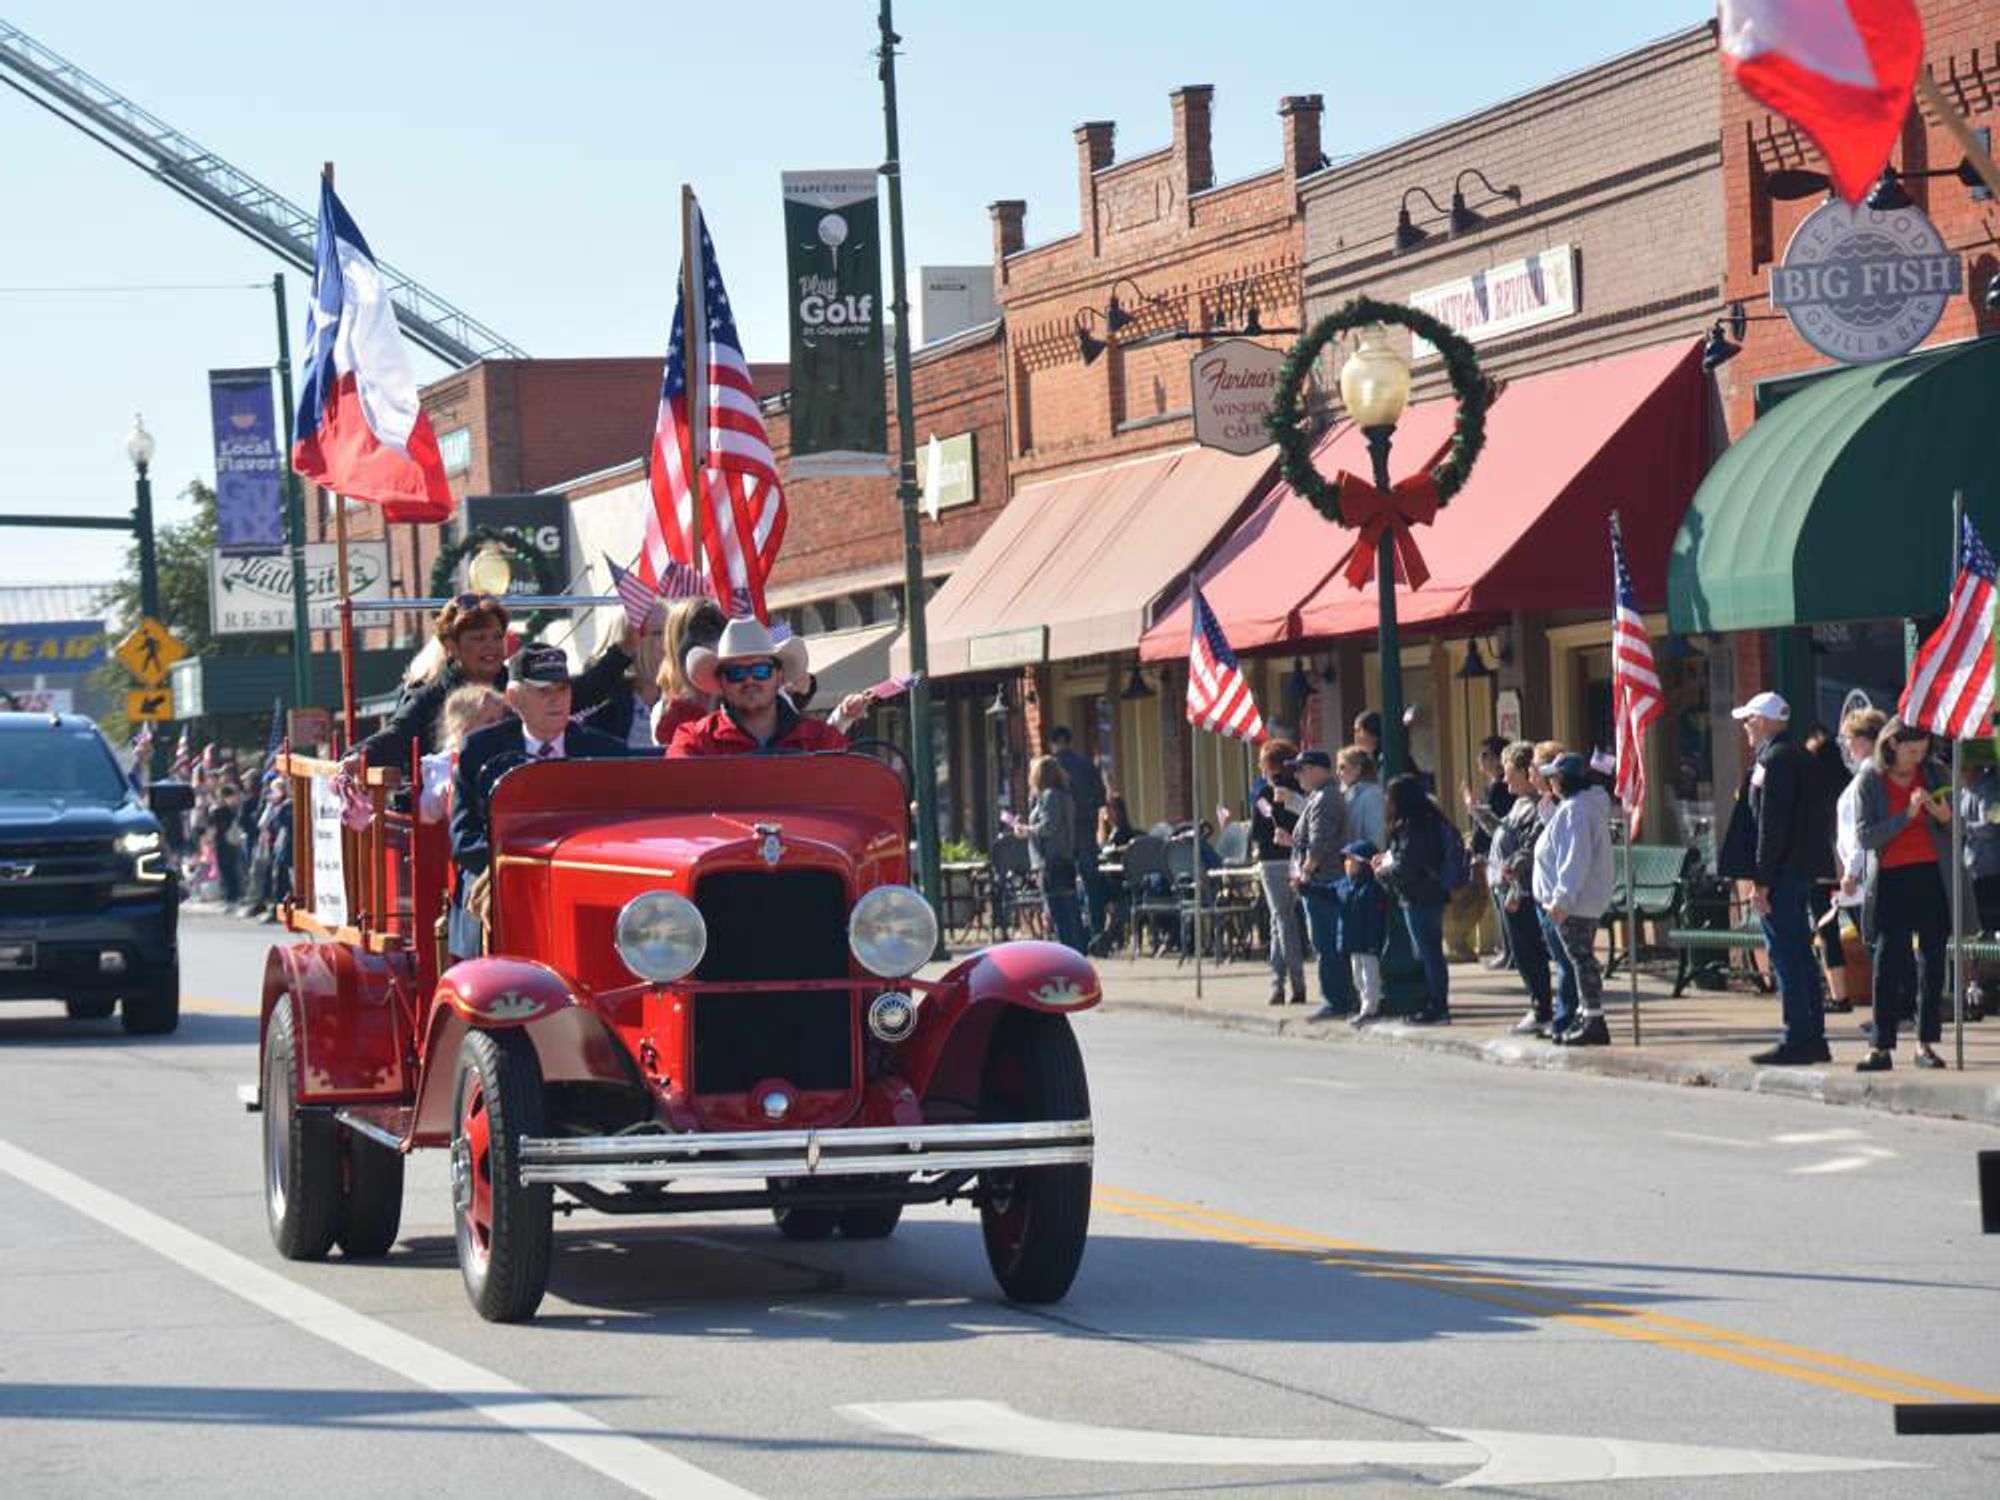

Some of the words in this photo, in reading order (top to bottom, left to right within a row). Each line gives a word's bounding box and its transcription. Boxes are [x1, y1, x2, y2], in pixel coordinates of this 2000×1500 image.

[1803, 205, 1928, 259] SEAOOD
[799, 273, 837, 301] Play
[1784, 266, 1850, 300] BIG
[1862, 258, 1952, 296] FISH
[800, 294, 872, 325] Golf
[1806, 310, 1866, 353] GRILL
[1896, 302, 1936, 340] BAR
[220, 439, 273, 456] Local
[218, 457, 276, 471] Flavor
